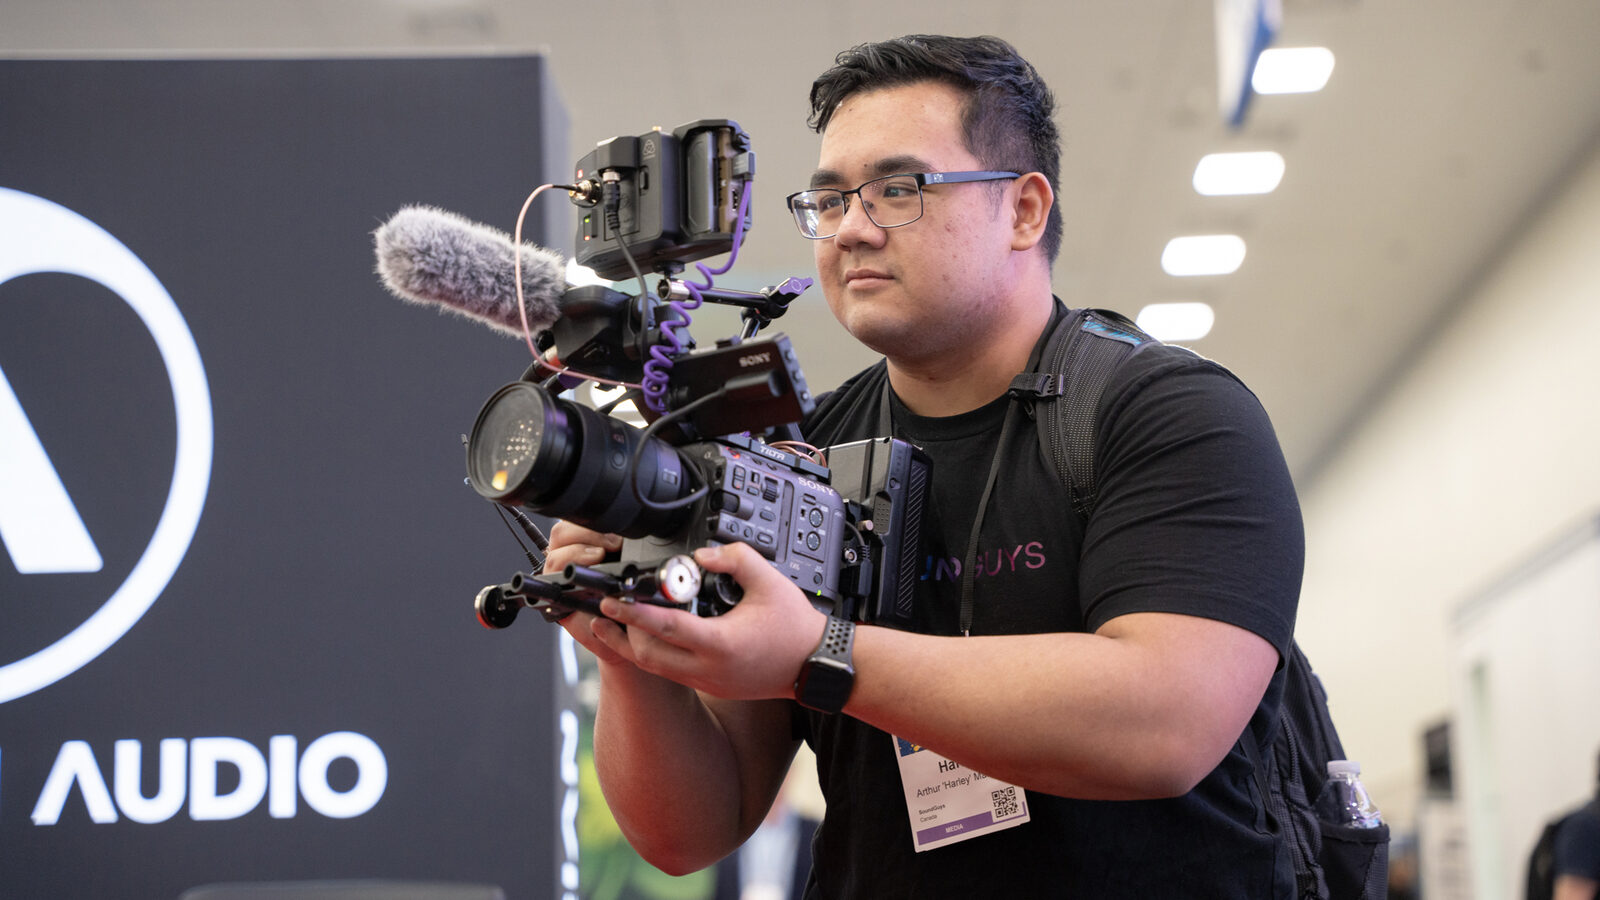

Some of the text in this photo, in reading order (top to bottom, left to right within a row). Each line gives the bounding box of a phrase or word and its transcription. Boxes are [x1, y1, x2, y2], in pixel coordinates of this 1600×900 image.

[739, 352, 771, 367] SONY
[759, 446, 785, 461] TILTA
[798, 476, 835, 497] SONY
[31, 731, 388, 826] AUDIO
[916, 783, 941, 798] Arthur
[918, 803, 946, 815] SoundGuys
[919, 814, 937, 823] Canada
[945, 823, 964, 834] MEDIA
